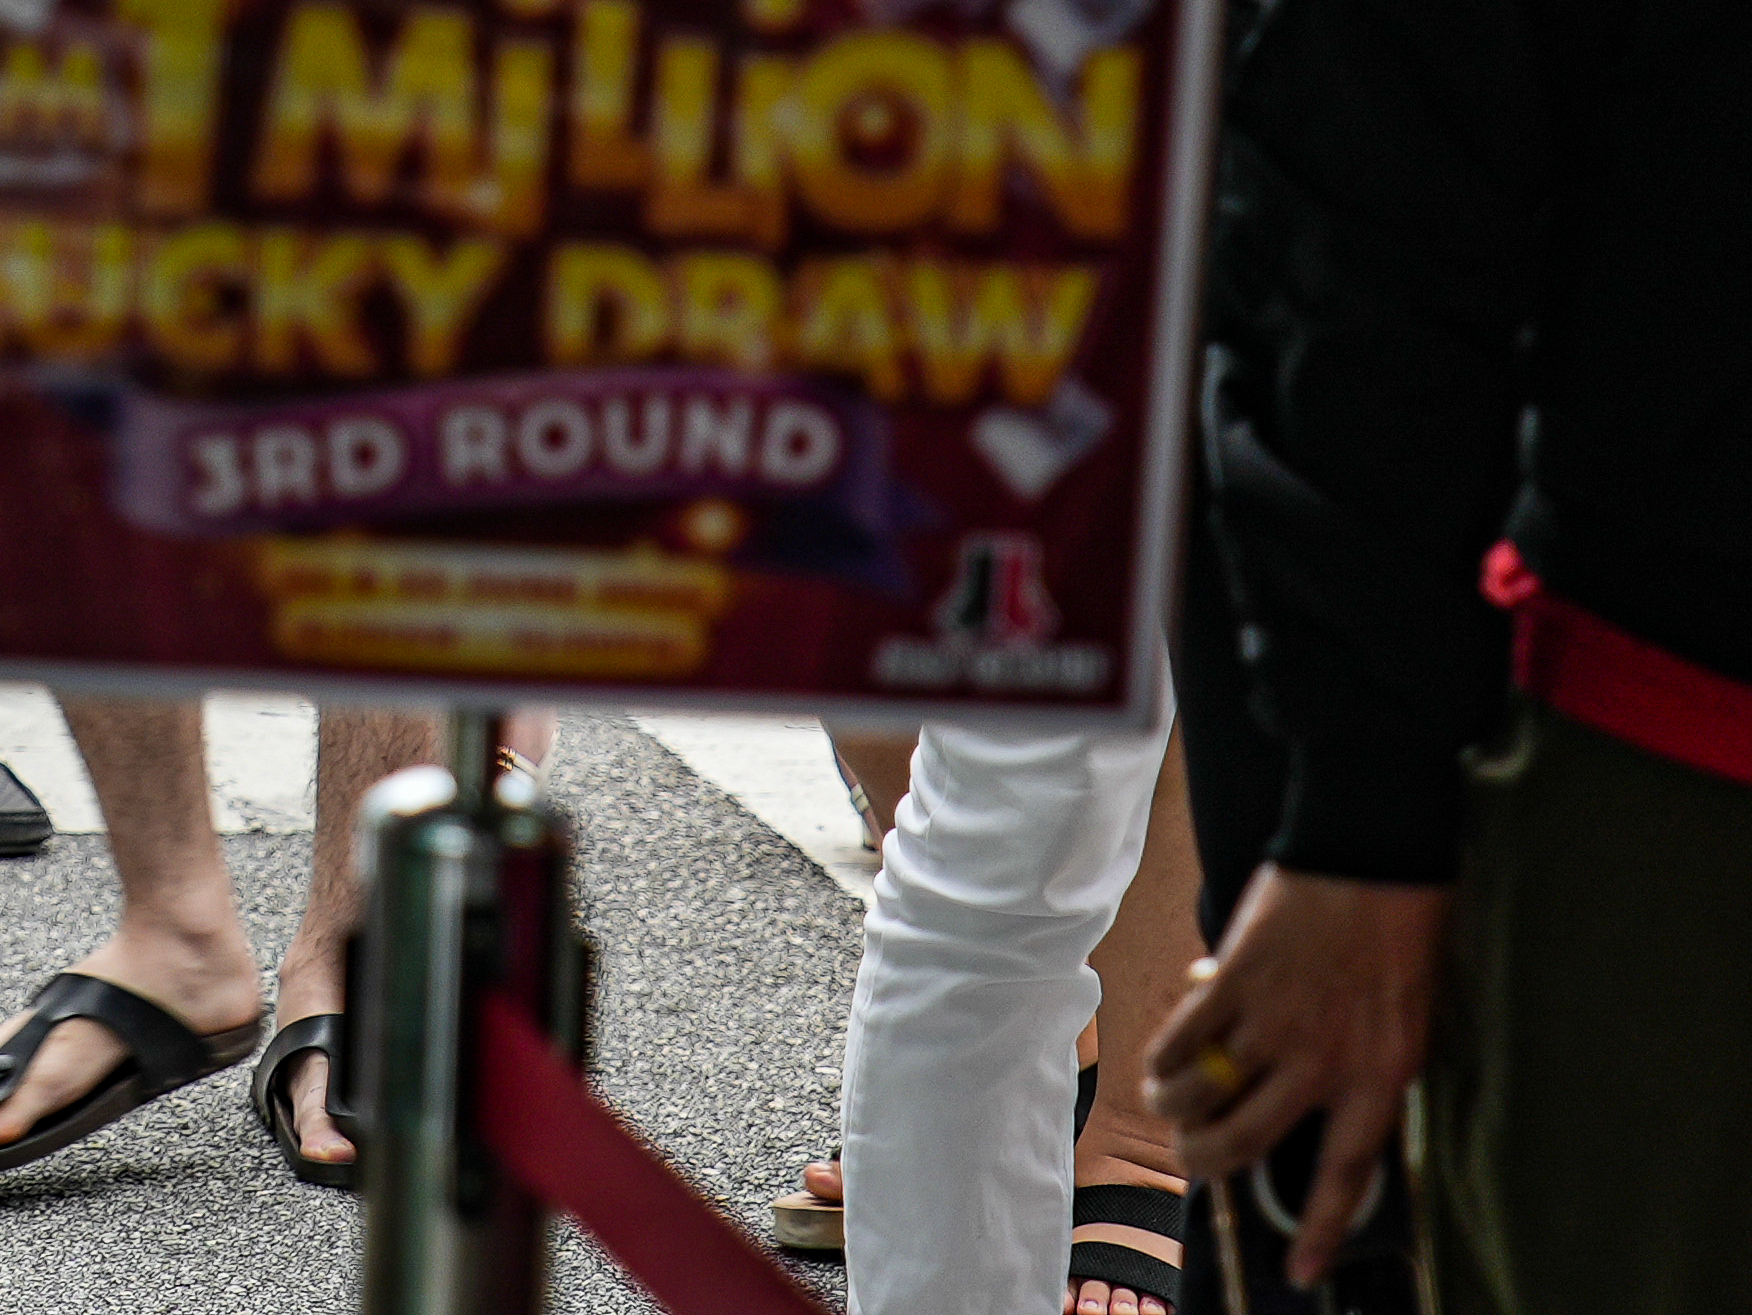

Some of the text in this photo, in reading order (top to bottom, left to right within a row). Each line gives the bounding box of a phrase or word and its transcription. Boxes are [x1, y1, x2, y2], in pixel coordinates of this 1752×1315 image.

[538, 237, 1098, 407] DRAW
[190, 397, 842, 515] 3RD ROUND
